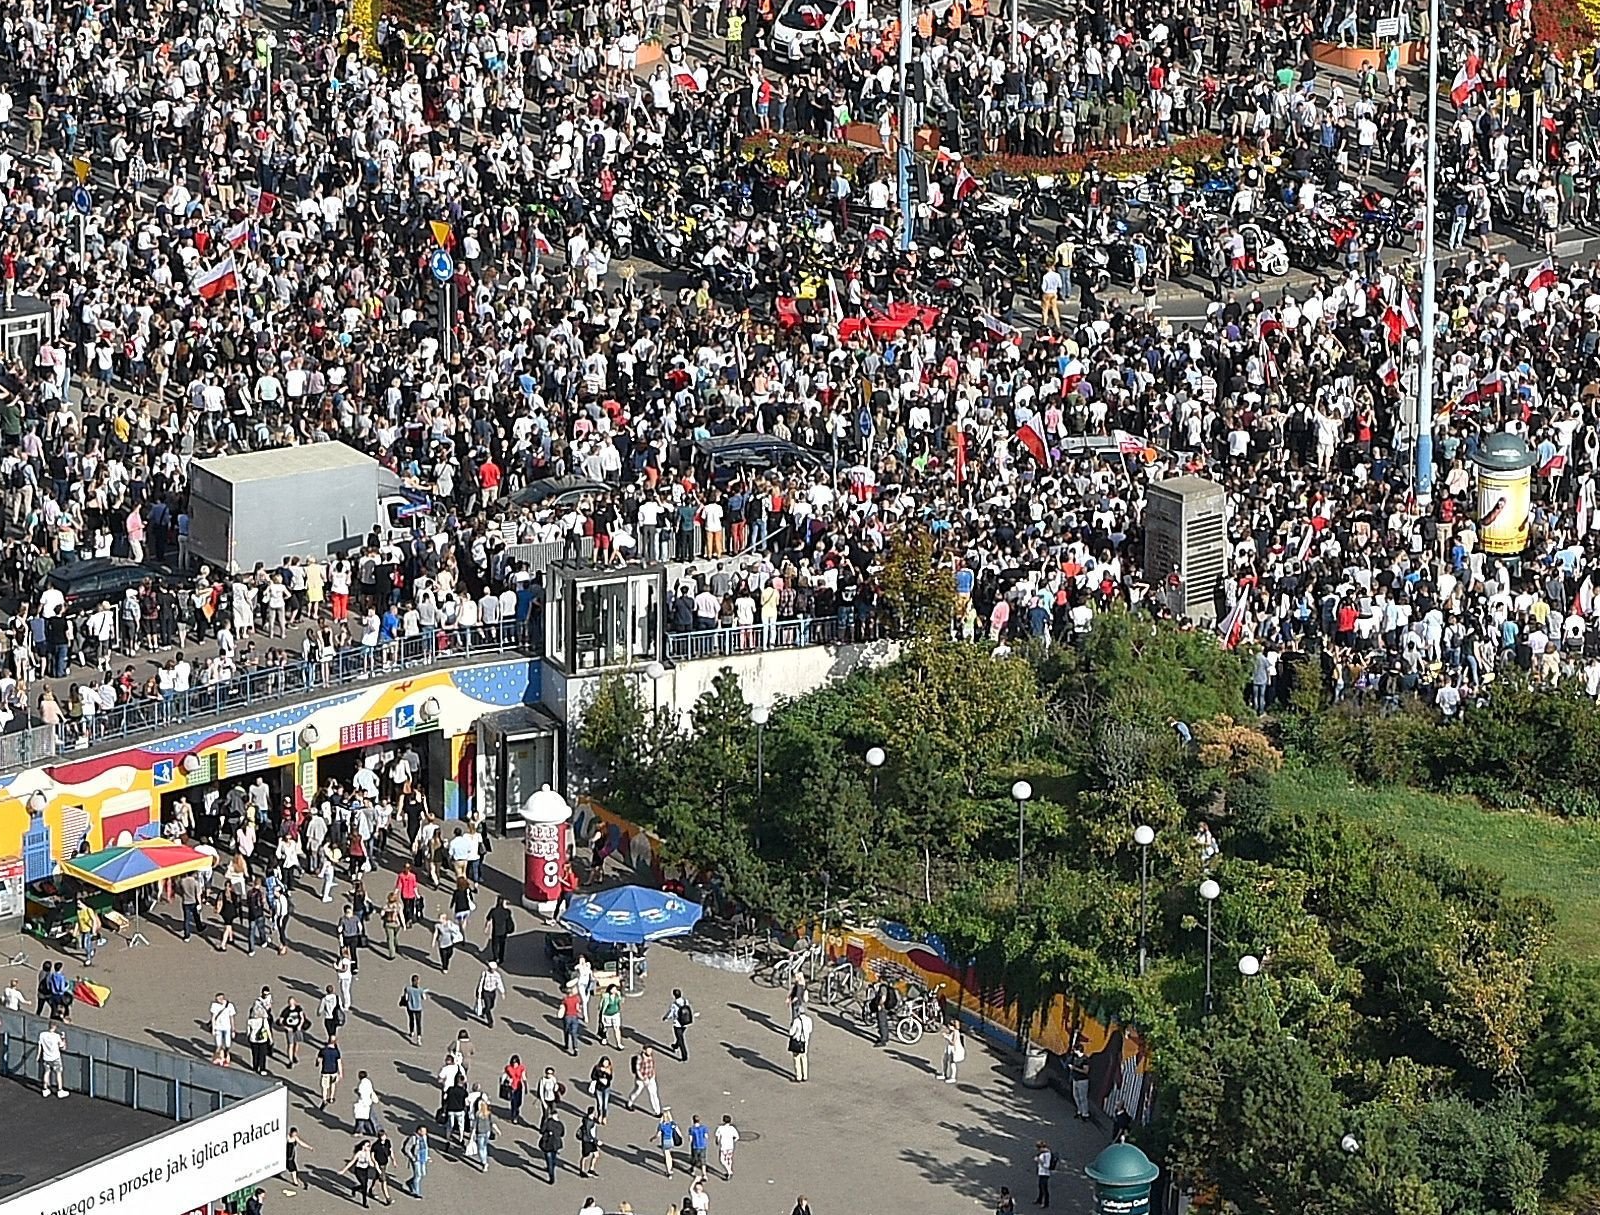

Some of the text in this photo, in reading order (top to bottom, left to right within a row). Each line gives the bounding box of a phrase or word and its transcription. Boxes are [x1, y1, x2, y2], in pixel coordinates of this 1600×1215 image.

[100, 1188, 115, 1205] są
[119, 1168, 163, 1201] proste
[166, 1153, 188, 1182] jak
[192, 1136, 230, 1169] iglica
[233, 1118, 280, 1151] Pałacu
